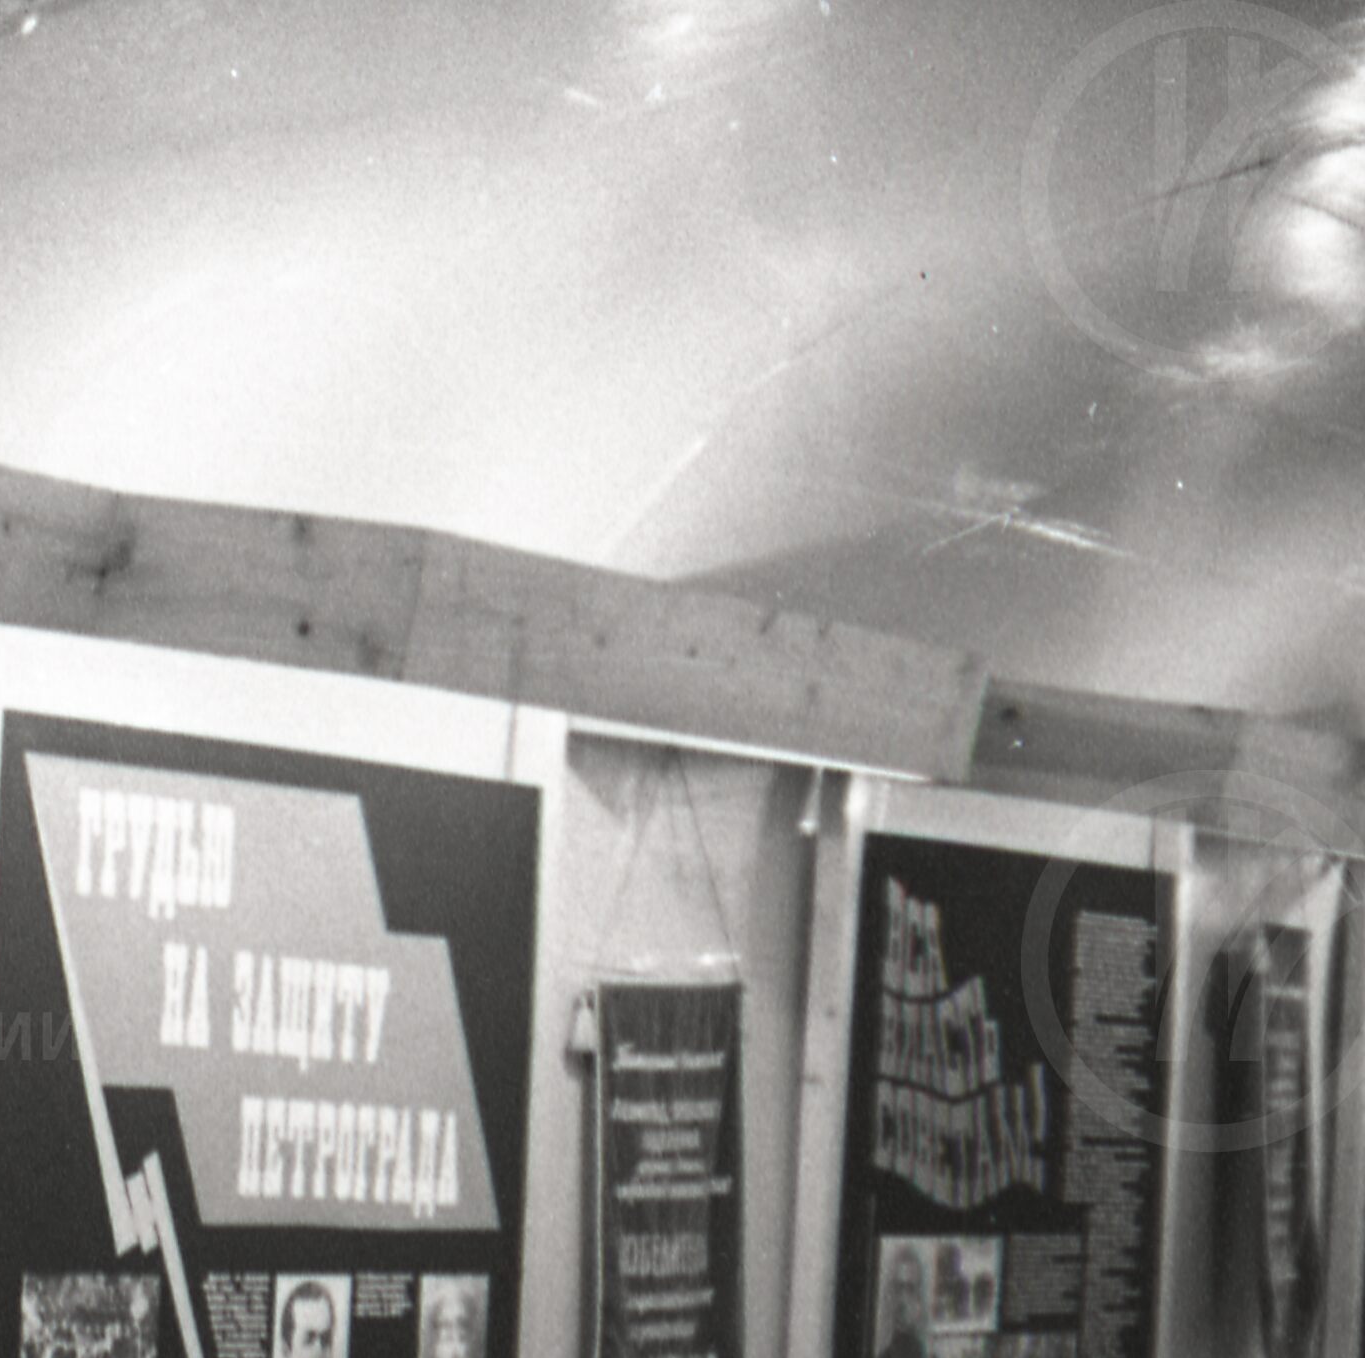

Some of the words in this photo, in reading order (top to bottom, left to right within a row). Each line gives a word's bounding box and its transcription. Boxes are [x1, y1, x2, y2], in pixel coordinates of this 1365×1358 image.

[75, 788, 235, 918] ГРУДЬЮ
[883, 874, 950, 998] ВСЯ
[160, 942, 210, 1048] НА
[230, 950, 390, 1071] ЗАЩИТУ
[879, 974, 1000, 1098] ВЛАСТЬ
[237, 1096, 459, 1217] ПЕТРОГРАДА
[874, 1062, 1045, 1209] СОВЕТАМ!
